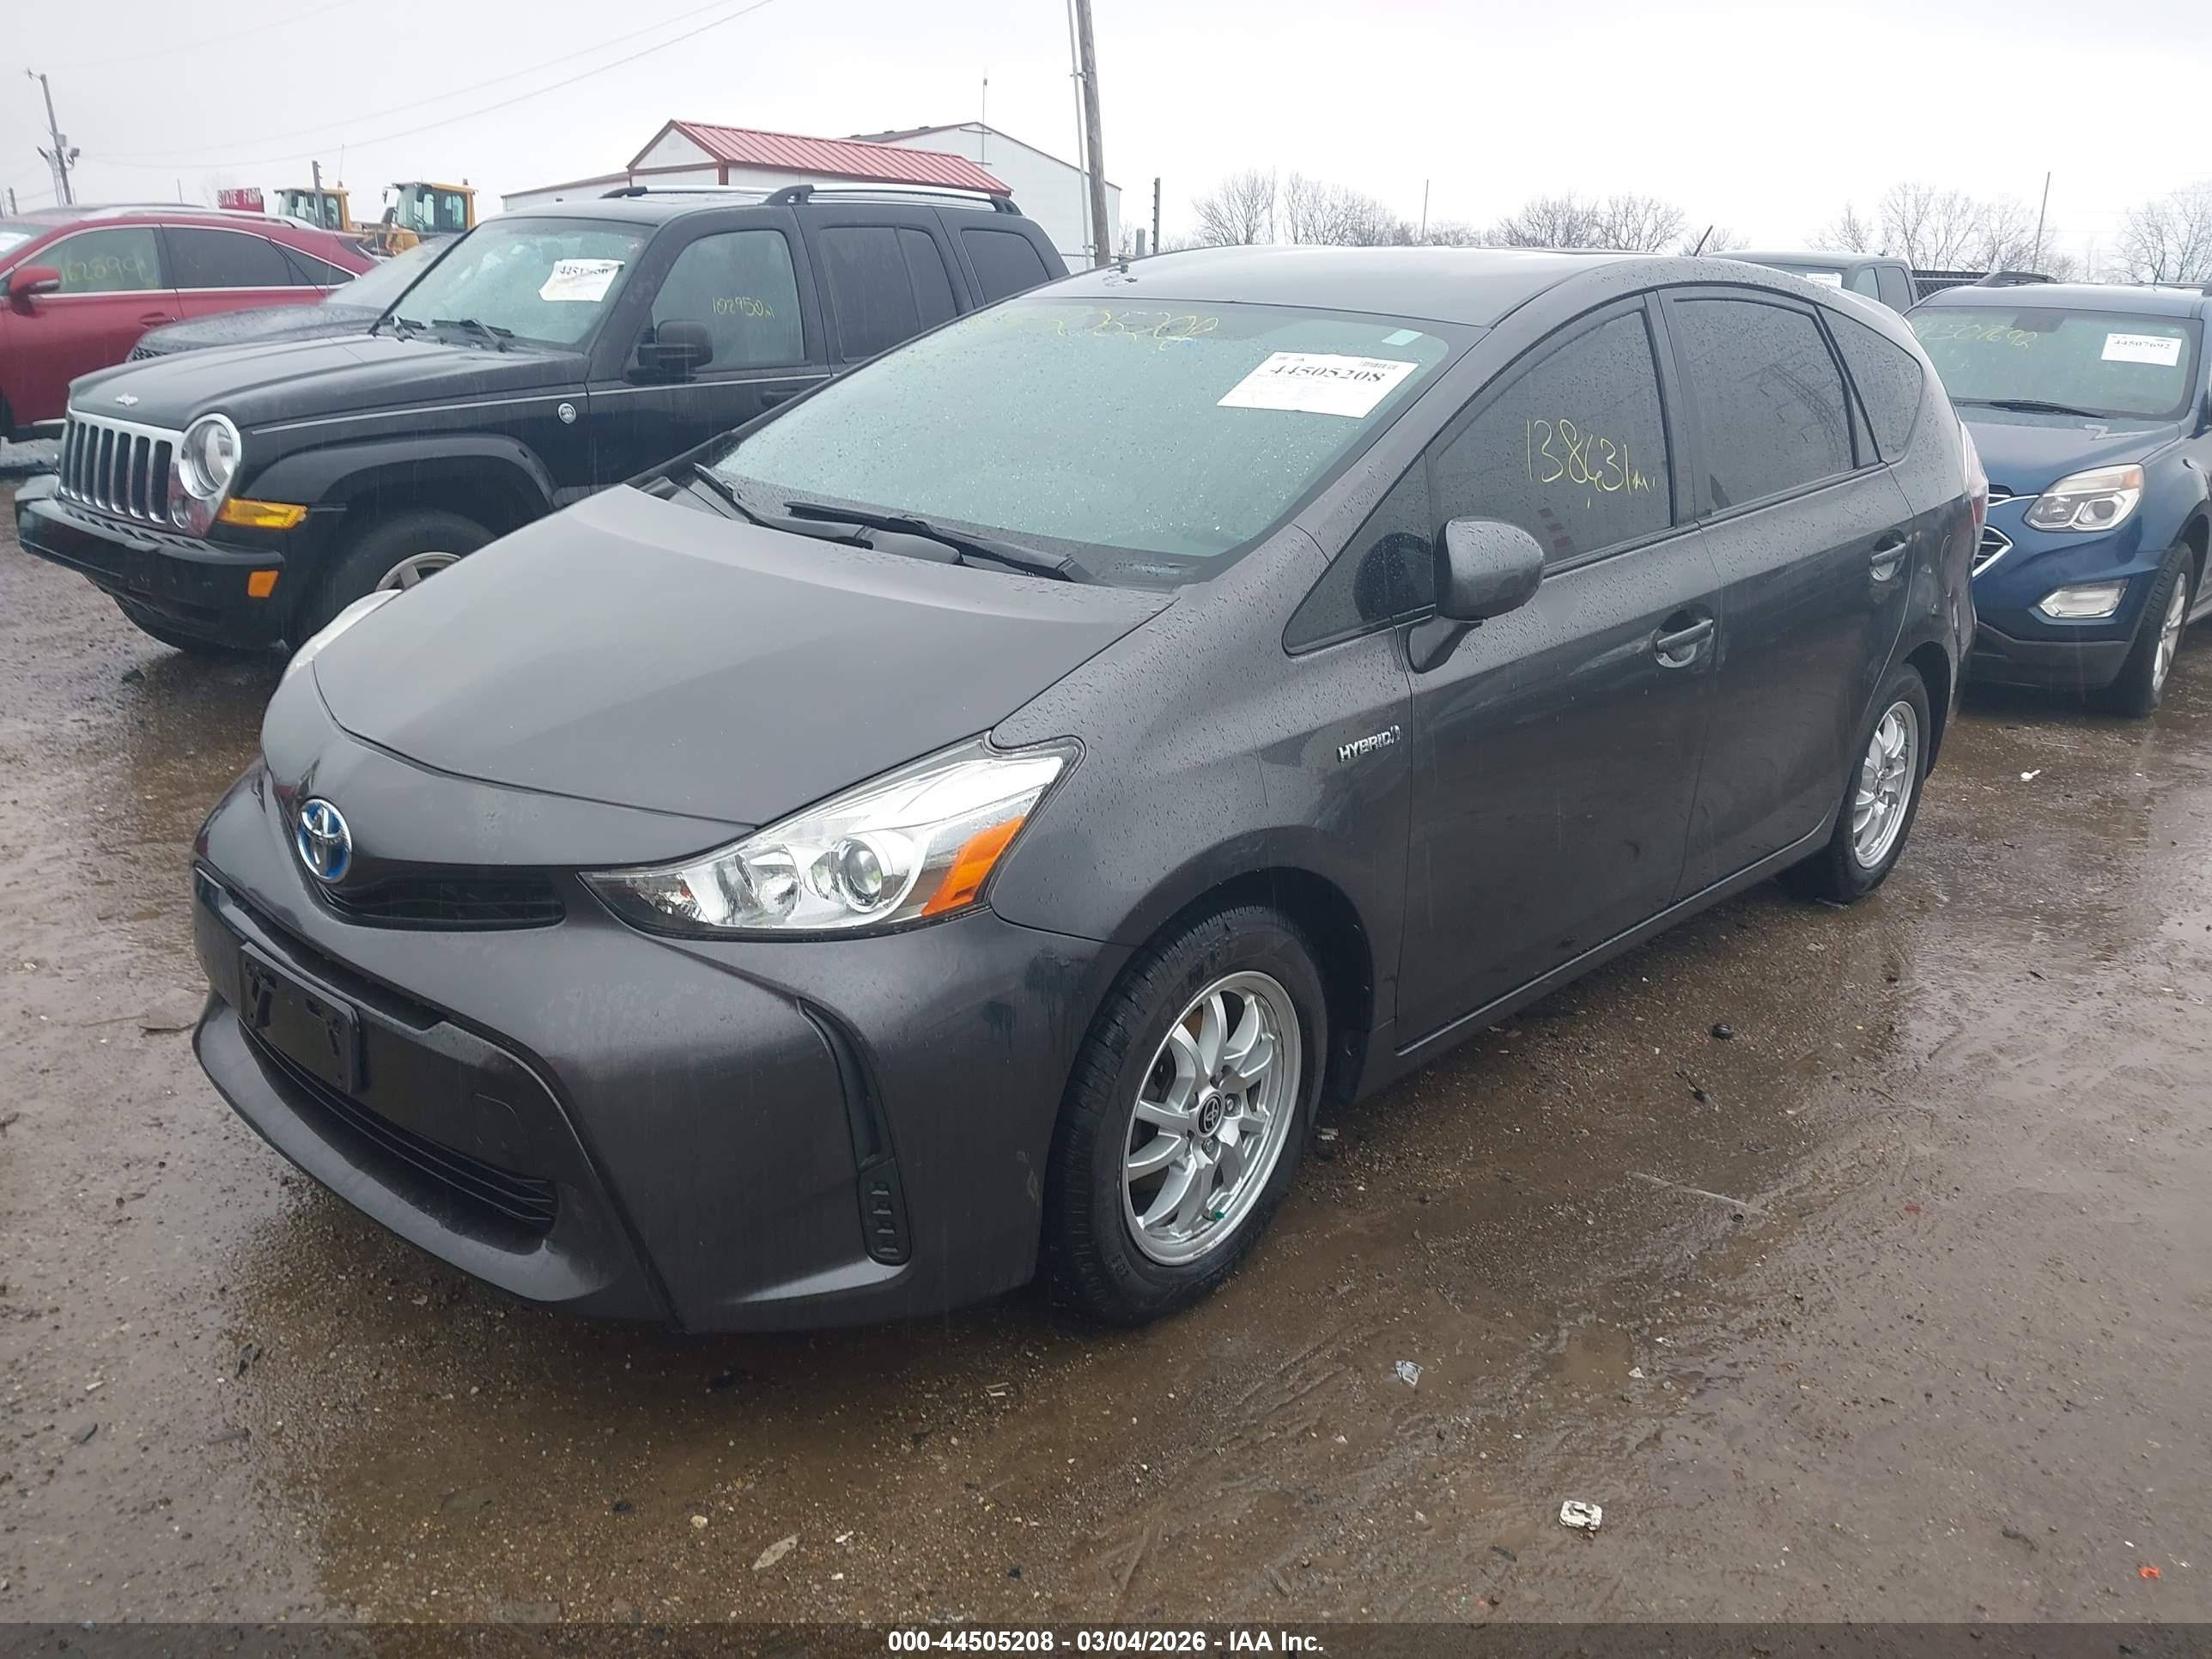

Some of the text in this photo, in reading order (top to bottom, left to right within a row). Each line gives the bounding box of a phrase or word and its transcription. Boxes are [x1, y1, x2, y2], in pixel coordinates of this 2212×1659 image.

[217, 189, 239, 206] STATE
[1270, 364, 1386, 383] 44505208
[1338, 731, 1393, 763] HYBRID
